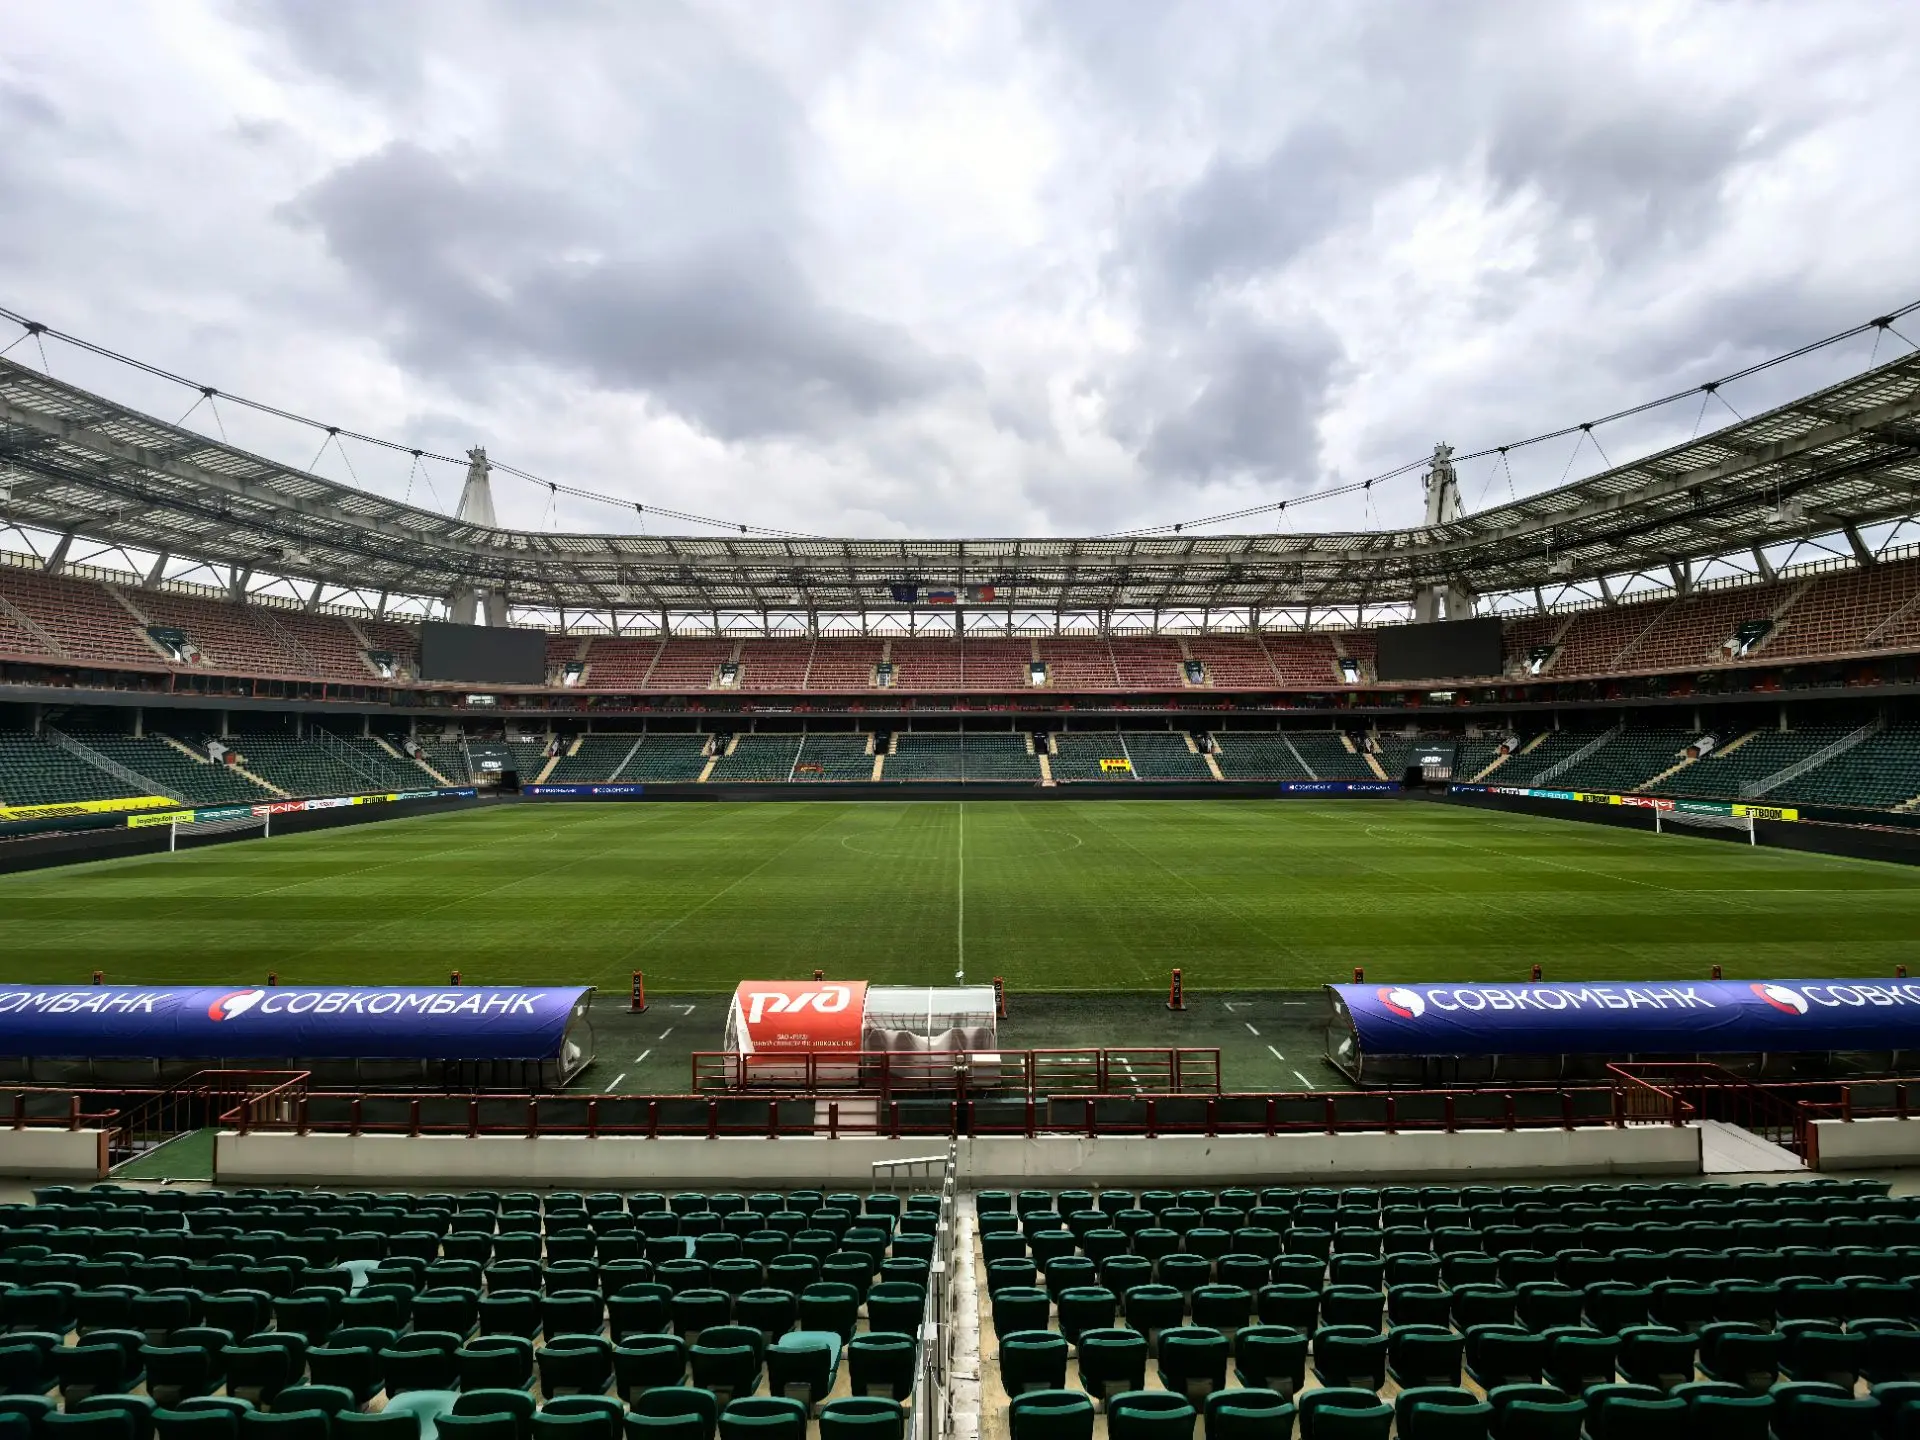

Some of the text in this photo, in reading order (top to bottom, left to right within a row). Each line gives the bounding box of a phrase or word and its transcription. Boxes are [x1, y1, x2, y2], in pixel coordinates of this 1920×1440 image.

[0, 992, 173, 1013] ОМБАНК
[260, 992, 547, 1014] СОВКОМБАНК
[1427, 988, 1716, 1010] СОВКОМБАНК
